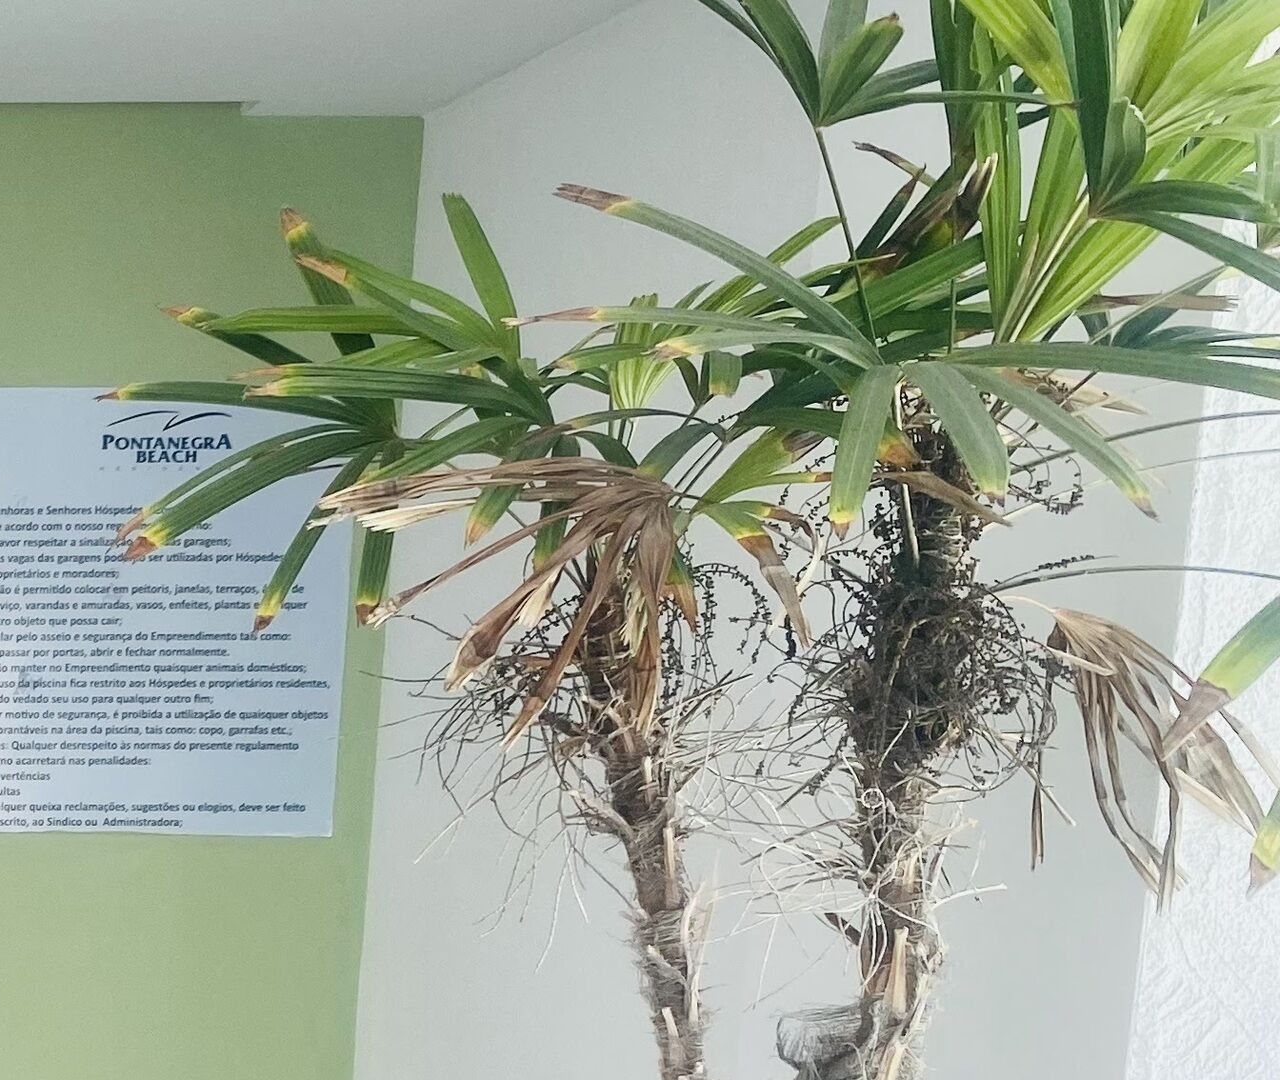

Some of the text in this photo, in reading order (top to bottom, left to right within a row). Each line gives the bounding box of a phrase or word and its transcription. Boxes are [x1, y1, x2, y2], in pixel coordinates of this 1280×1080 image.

[102, 434, 232, 450] PONTANEGRA
[136, 451, 197, 463] BEACH
[46, 506, 93, 515] Senhores
[4, 522, 39, 532] acordo
[24, 537, 68, 549] respeitar
[184, 538, 232, 548] garagens;
[8, 556, 35, 565] vagas
[38, 552, 55, 563] das
[57, 555, 101, 565] garagens
[148, 554, 164, 562] ser
[166, 552, 214, 562] utilizadas
[216, 554, 234, 564] por
[62, 568, 119, 580] moradores;
[23, 584, 72, 597] permitido
[74, 584, 110, 594] colocar
[131, 584, 172, 596] peitoris,
[174, 584, 213, 596] janelas,
[26, 600, 70, 610] varandas
[81, 598, 133, 611] amuradas,
[136, 602, 167, 611] vasos,
[168, 600, 212, 611] enfeites,
[214, 600, 251, 611] plantas
[14, 616, 46, 628] objeto
[49, 618, 68, 627] que
[70, 618, 98, 627] possa
[16, 632, 38, 643] pelo
[40, 632, 71, 642] asseio
[82, 634, 133, 643] segurança
[150, 631, 238, 643] Empreendimento
[33, 650, 50, 659] por
[52, 649, 87, 659] portas,
[90, 648, 114, 657] abrir
[126, 646, 157, 657] fechar
[159, 648, 230, 657] normalmente.
[11, 664, 47, 674] manter
[65, 663, 151, 674] Empreendimento
[154, 663, 204, 674] quaisquer
[206, 663, 245, 672] animais
[32, 678, 67, 690] piscina
[70, 678, 87, 688] fica
[90, 679, 126, 688] restrito
[149, 678, 197, 690] Hóspedes
[208, 678, 274, 690] proprietários
[275, 678, 331, 690] residentes,
[13, 694, 49, 704] vedado
[72, 696, 89, 704] uso
[92, 696, 114, 706] para
[116, 694, 162, 705] qualquer
[164, 696, 191, 704] outro
[194, 694, 214, 705] fim;
[5, 710, 40, 719] motivo
[42, 710, 55, 719] de
[121, 710, 163, 721] proibida
[174, 710, 222, 721] utilização
[224, 710, 237, 719] de
[239, 709, 289, 721] quaisquer
[291, 710, 329, 721] objetos
[66, 725, 88, 735] área
[105, 725, 142, 736] piscina,
[145, 725, 163, 735] tais
[166, 727, 196, 735] como:
[199, 727, 226, 737] copo,
[228, 725, 269, 737] garrafas
[12, 740, 58, 752] Qualquer
[60, 740, 118, 752] desrespeito
[134, 742, 172, 750] normas
[189, 742, 233, 752] presente
[235, 741, 299, 752] regulamento
[16, 756, 66, 766] acarretará
[68, 758, 86, 766] nas
[88, 756, 152, 768] penalidades:
[29, 802, 62, 813] queixa
[131, 802, 180, 814] sugestões
[198, 802, 237, 814] elogios,
[238, 803, 264, 812] deve
[265, 804, 281, 812] ser
[283, 802, 306, 812] feito
[103, 817, 183, 828] Administradora;
